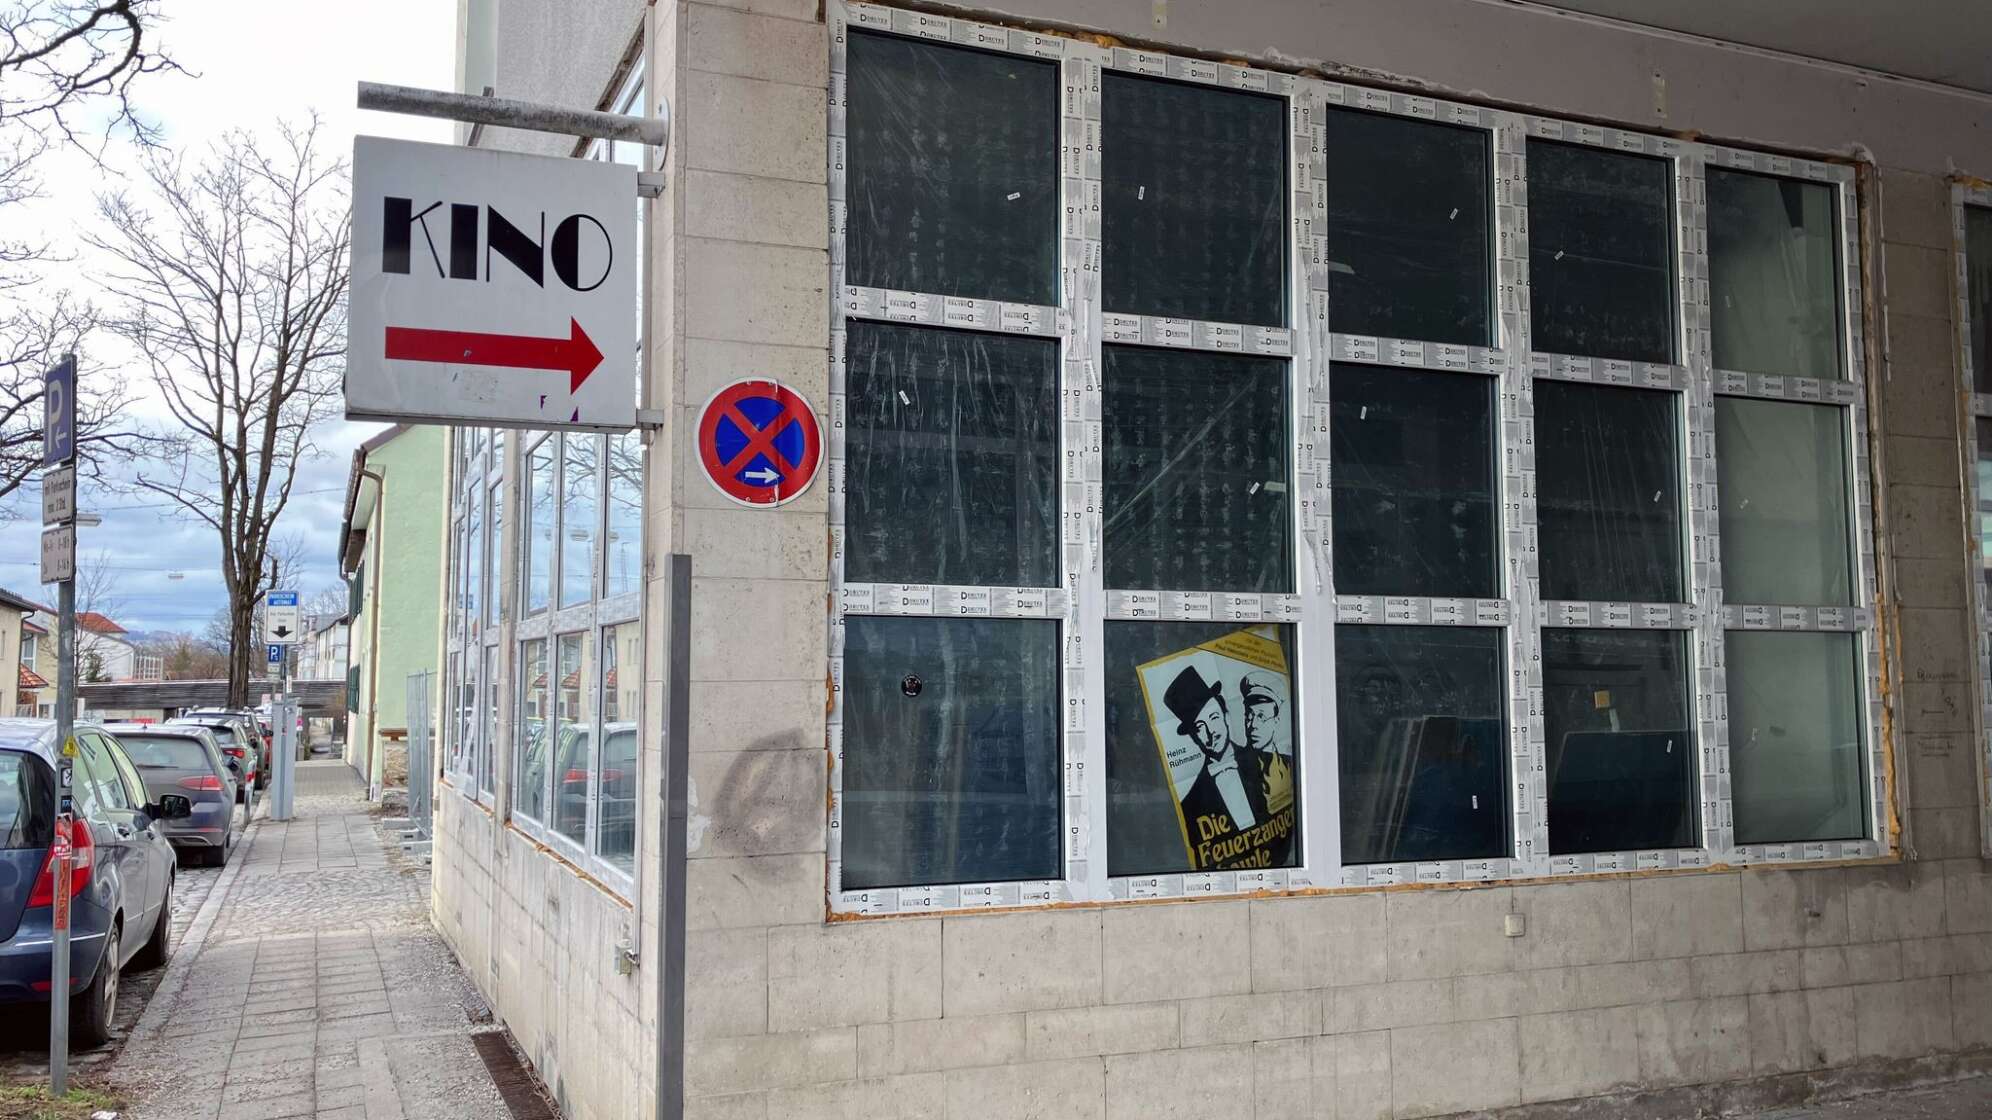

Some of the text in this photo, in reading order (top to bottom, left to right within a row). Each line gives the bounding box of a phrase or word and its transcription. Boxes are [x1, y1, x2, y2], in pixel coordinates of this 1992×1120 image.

[382, 196, 613, 292] KINO
[48, 379, 63, 453] P
[270, 646, 278, 660] P
[1167, 747, 1186, 759] Heinz
[1169, 752, 1202, 768] Rühmann
[1196, 812, 1231, 841] Die
